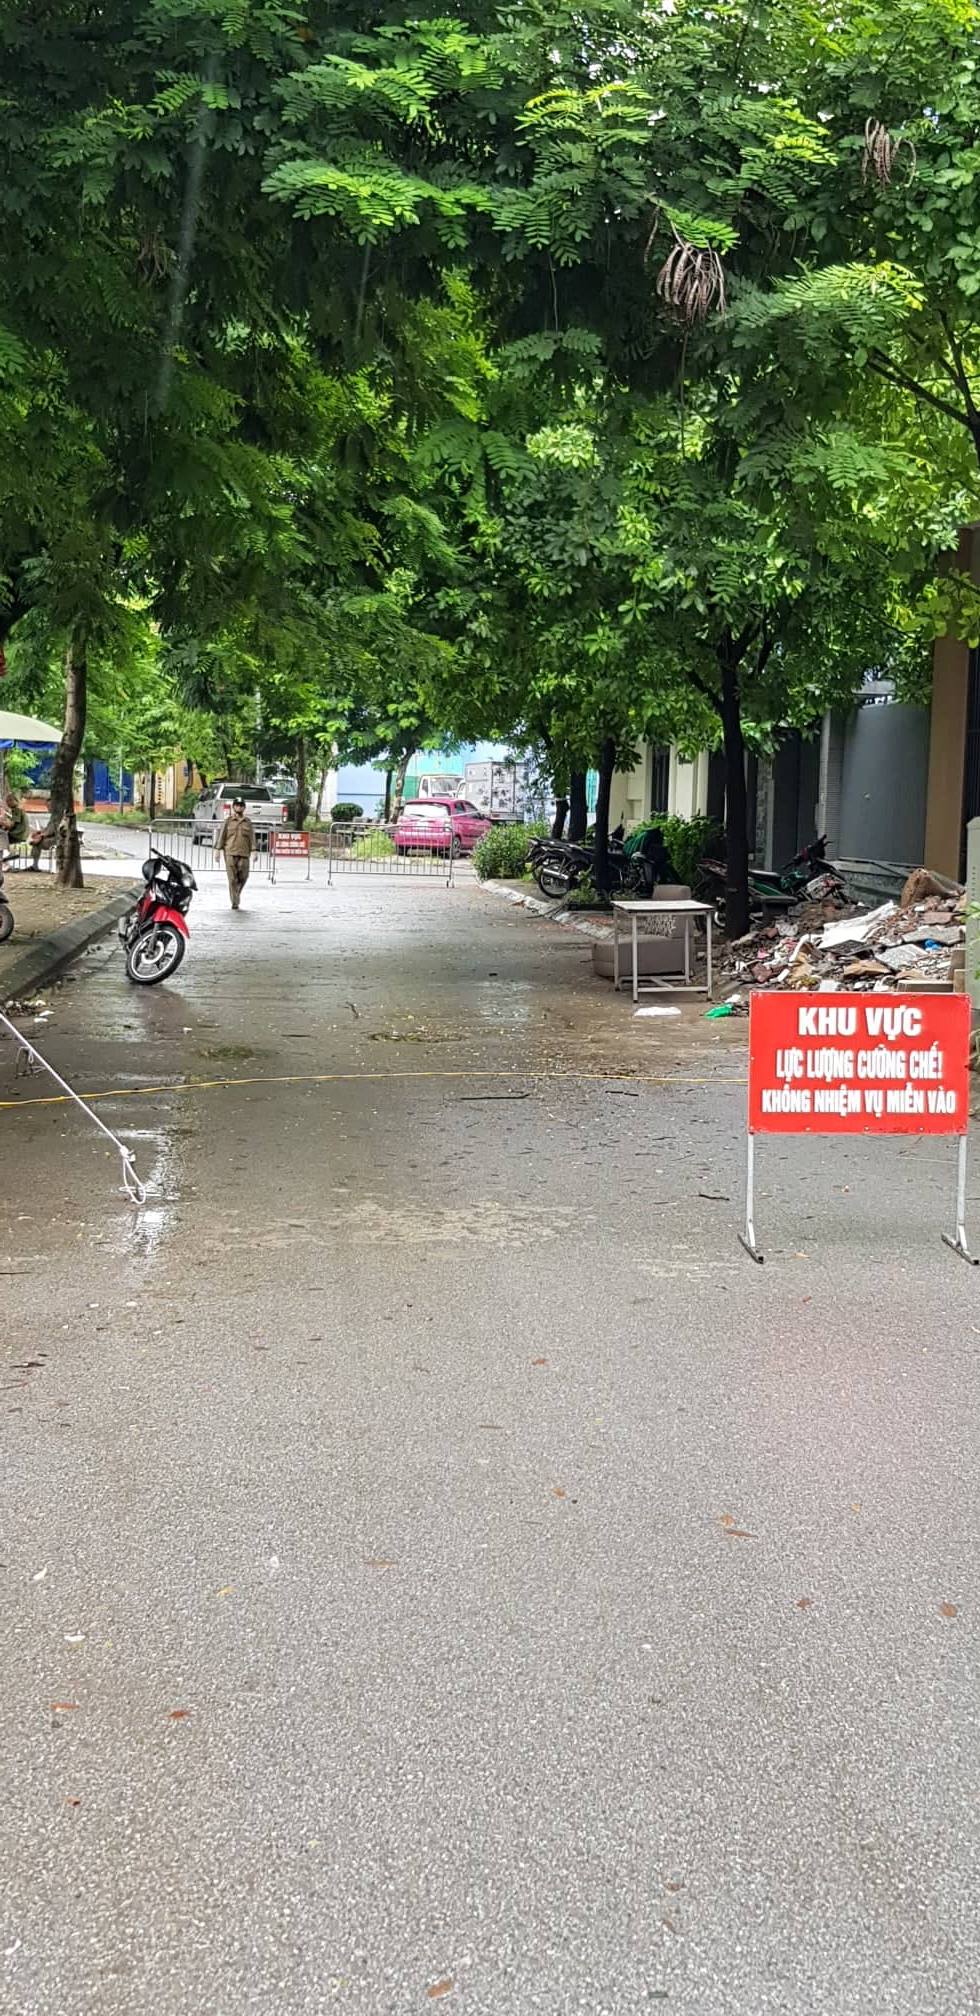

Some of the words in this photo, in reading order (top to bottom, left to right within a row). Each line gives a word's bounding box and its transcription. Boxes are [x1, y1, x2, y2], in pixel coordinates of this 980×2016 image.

[799, 1007, 857, 1036] KHU
[866, 1005, 922, 1040] VỰC
[776, 1046, 803, 1082] LỰC
[807, 1046, 854, 1082] LƯỢNG
[857, 1044, 906, 1079] CƯỠNG
[909, 1041, 943, 1079] CHẾ!
[762, 1084, 811, 1113] KHÔNG
[814, 1084, 861, 1117] NHIỆM
[864, 1089, 884, 1118] VỤ
[927, 1085, 956, 1114] VÀO
